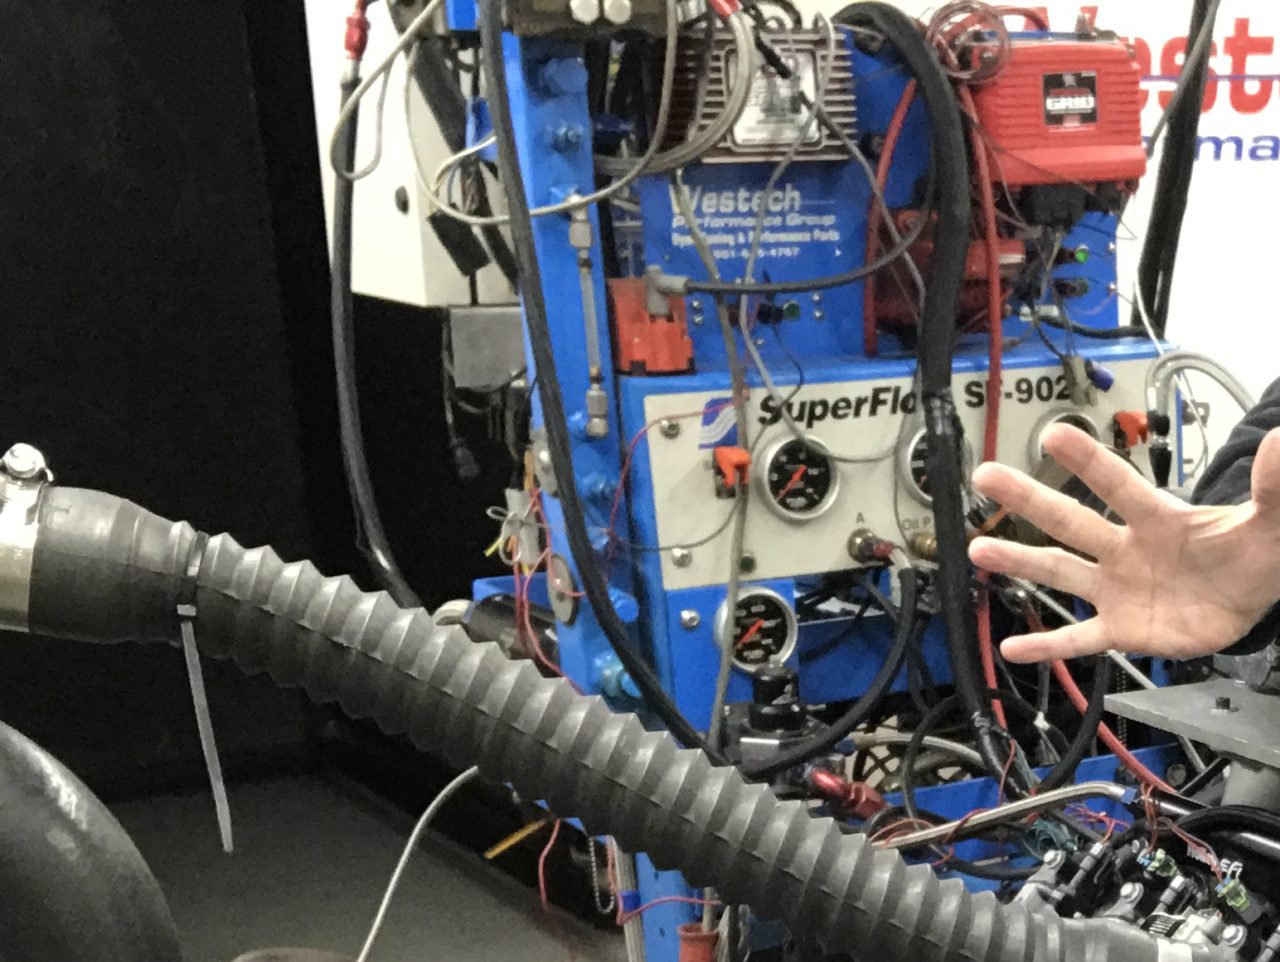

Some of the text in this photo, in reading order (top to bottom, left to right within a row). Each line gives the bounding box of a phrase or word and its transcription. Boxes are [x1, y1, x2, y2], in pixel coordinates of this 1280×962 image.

[672, 214, 782, 229] Prformace
[758, 375, 1071, 429] SuperFlo S-902
